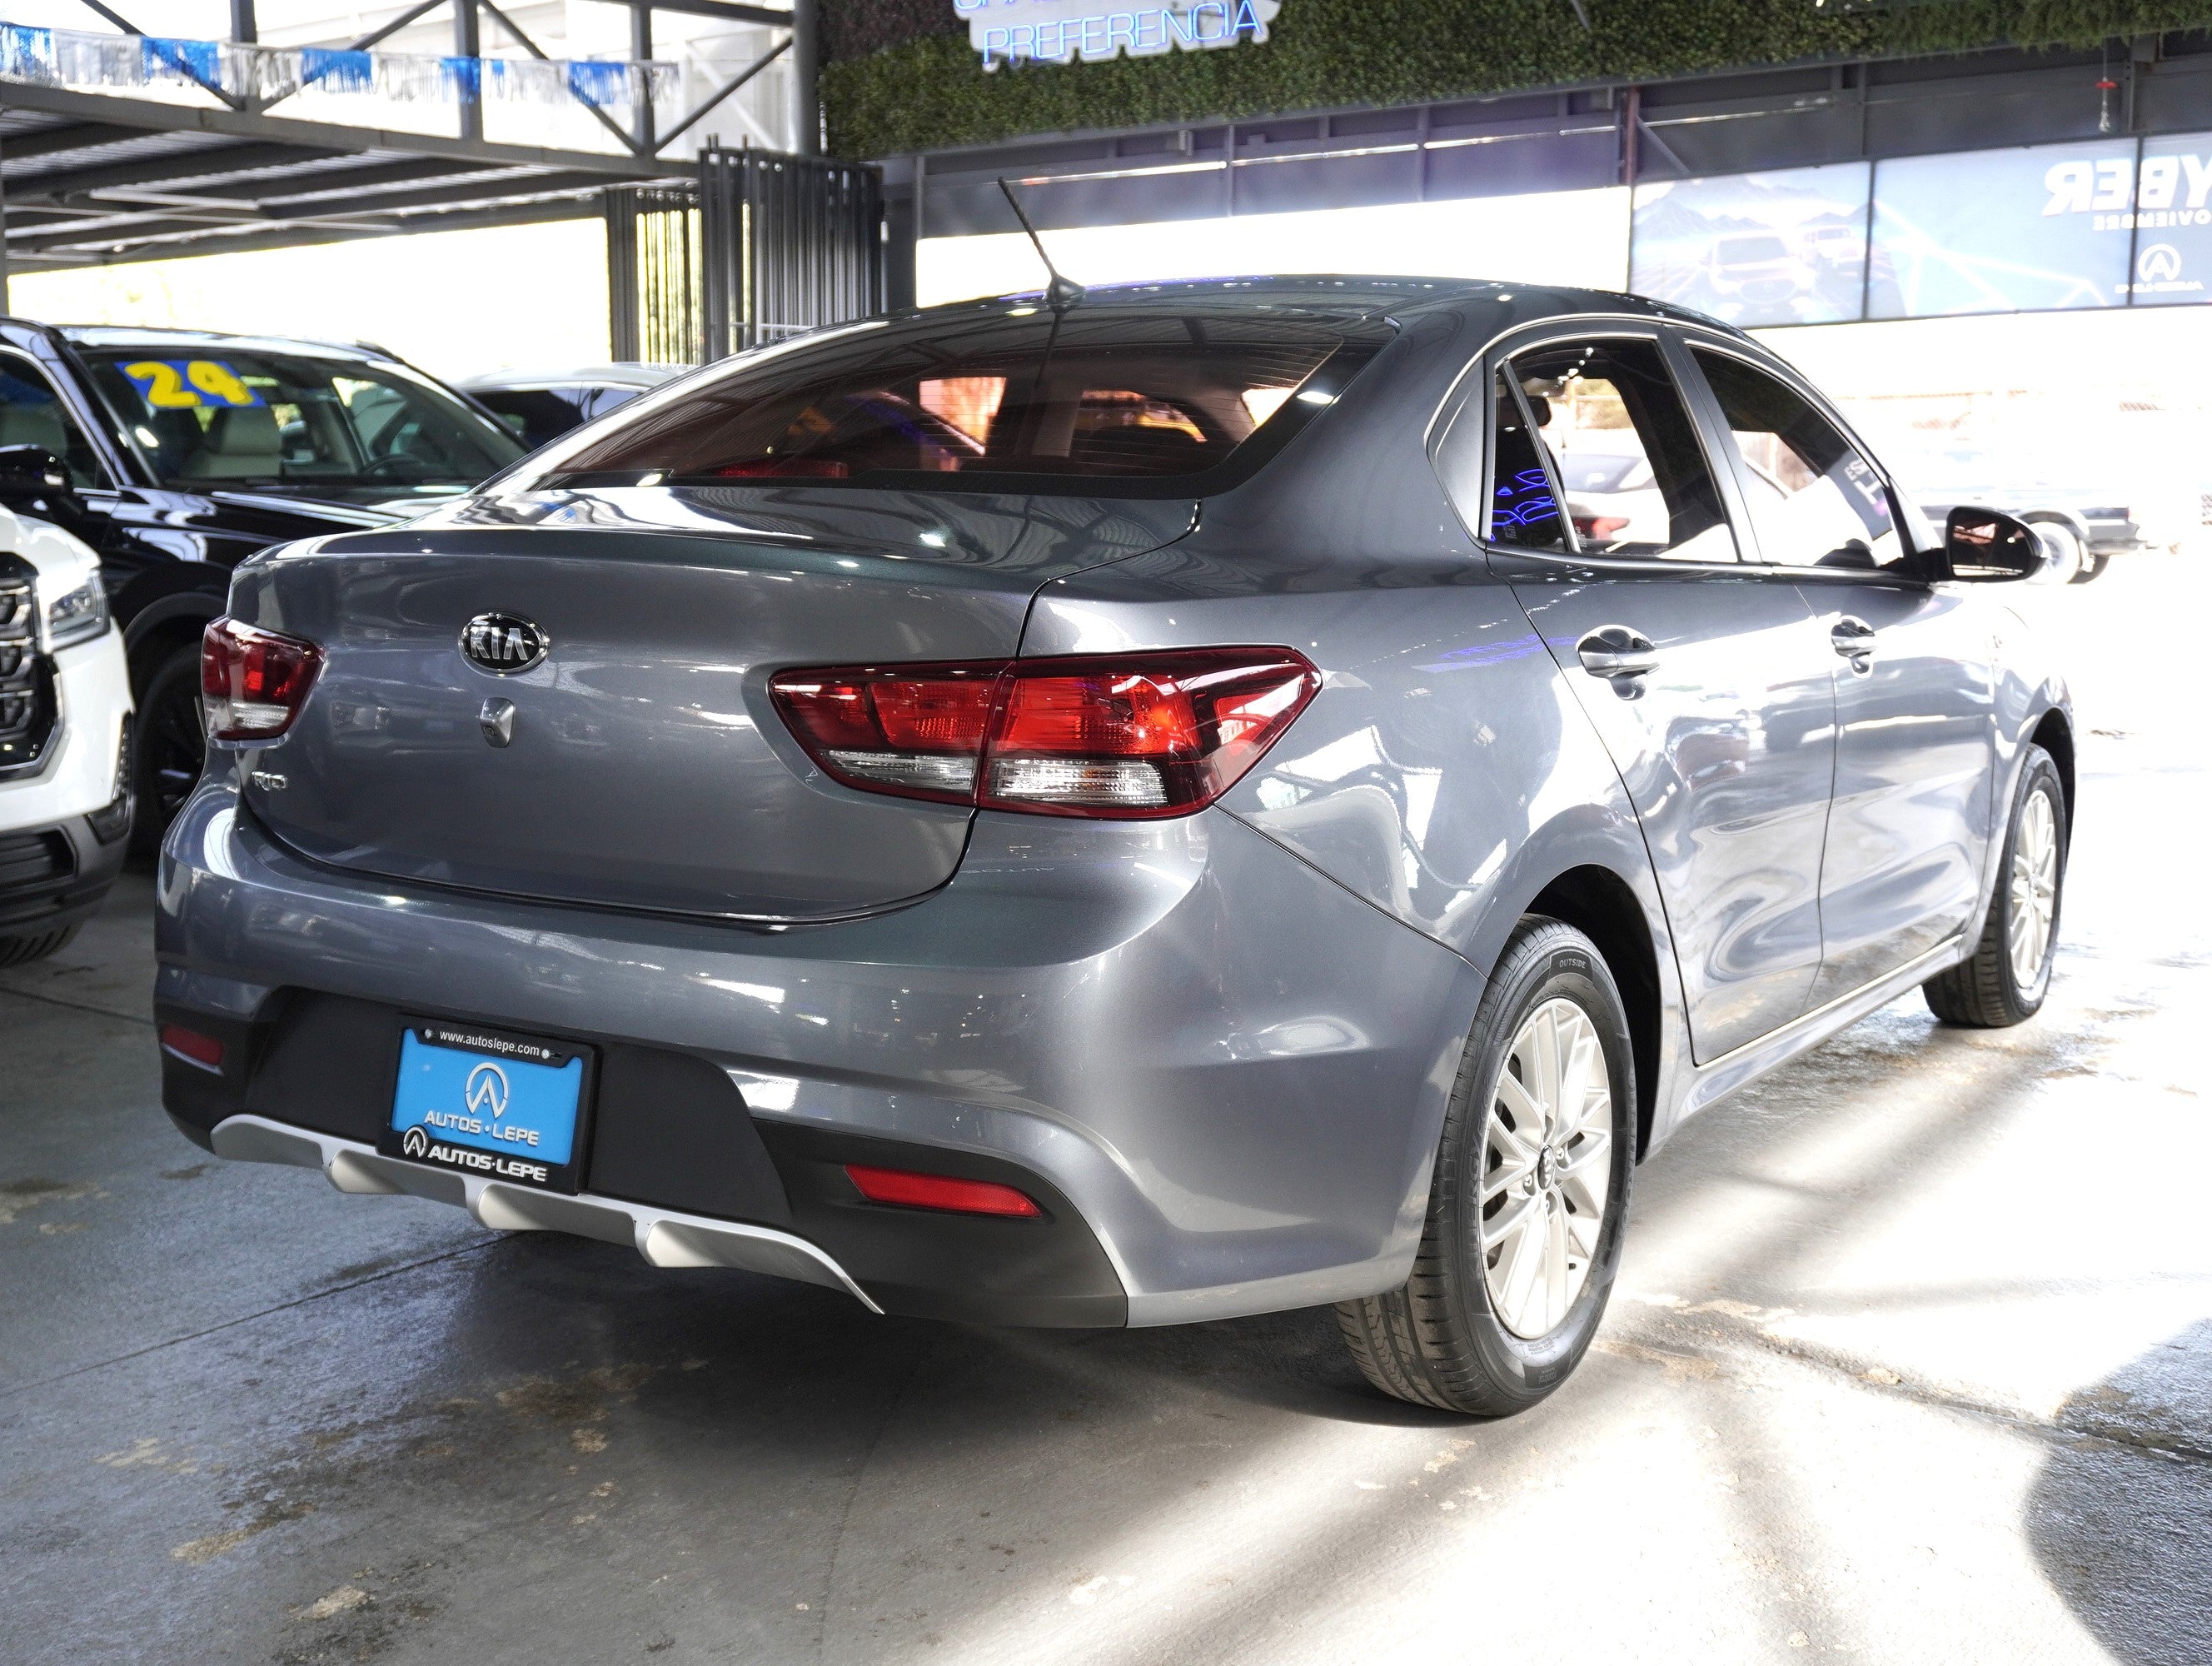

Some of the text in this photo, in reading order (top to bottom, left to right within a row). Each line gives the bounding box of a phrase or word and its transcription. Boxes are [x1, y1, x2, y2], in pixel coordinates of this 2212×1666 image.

[983, 0, 1261, 64] PREFERENCIA
[470, 626, 528, 660] KIA
[1559, 958, 1587, 970] OUTSIDE
[440, 1030, 540, 1056] www.autoslepe.com
